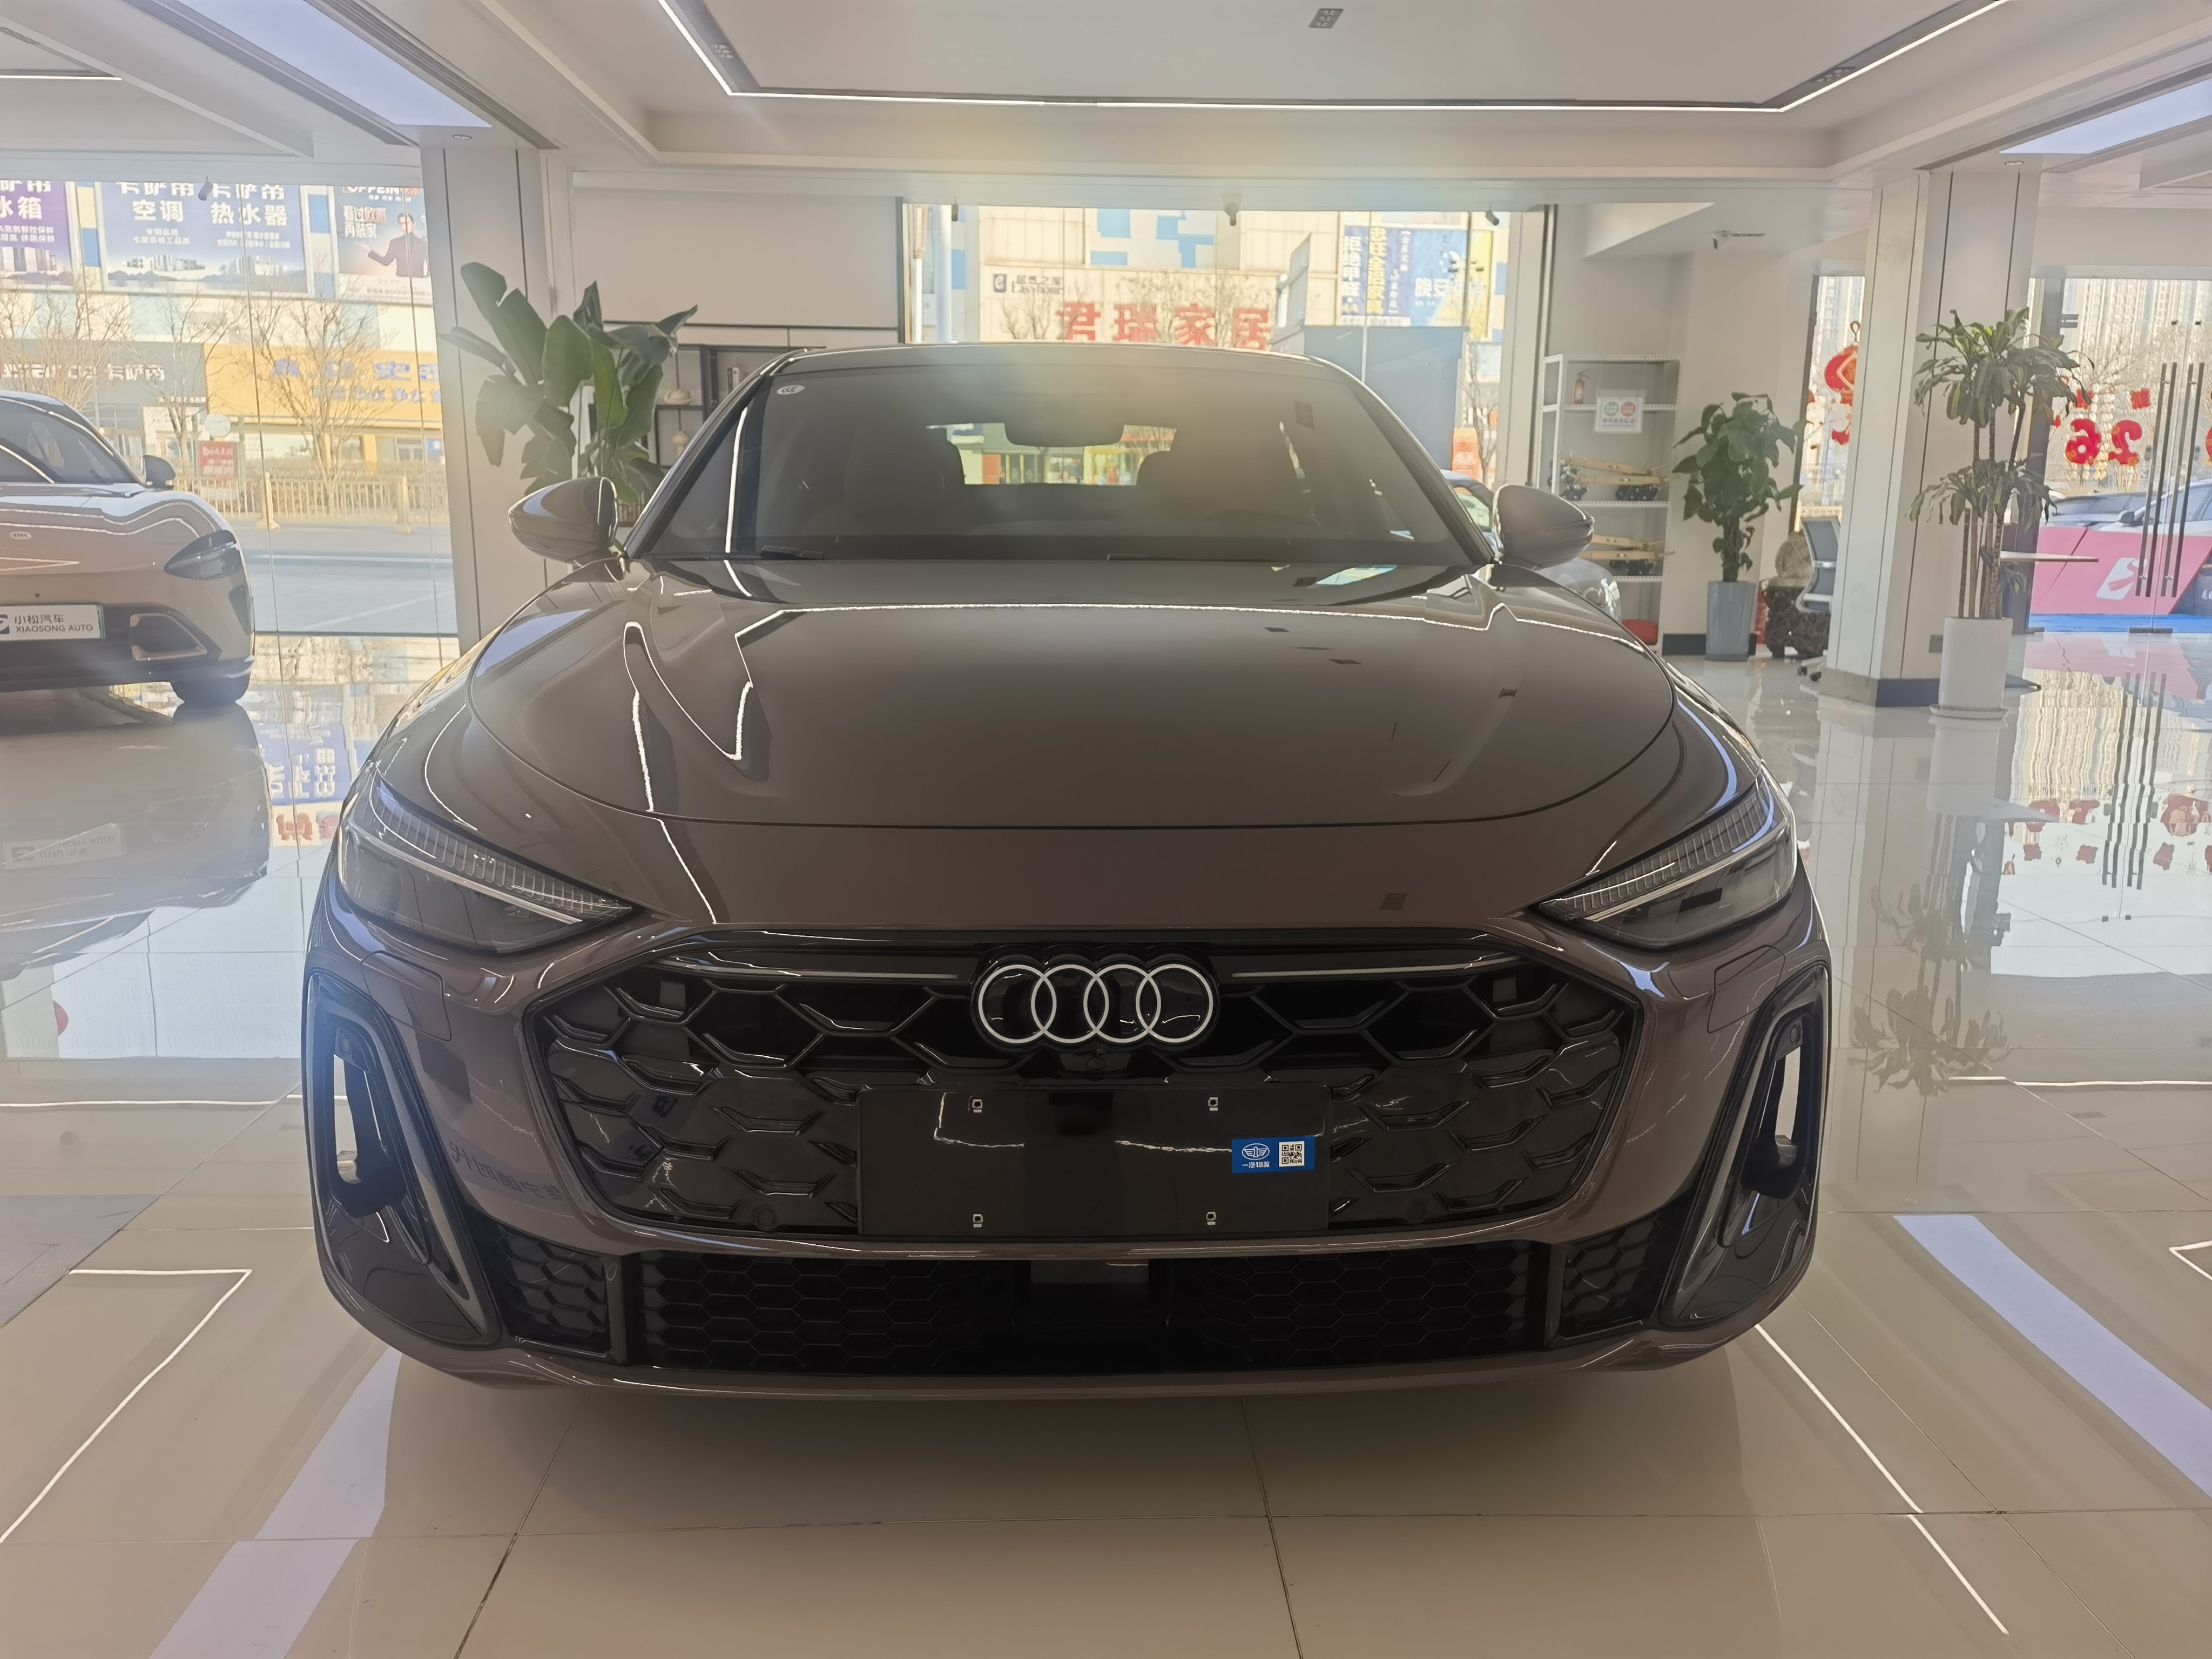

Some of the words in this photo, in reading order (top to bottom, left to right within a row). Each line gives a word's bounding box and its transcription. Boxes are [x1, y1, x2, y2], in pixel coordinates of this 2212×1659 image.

[132, 199, 184, 222] 空调
[211, 201, 287, 226] 热水器
[15, 614, 65, 625] 小松汽车
[16, 624, 65, 633] XIAOSONG
[69, 624, 93, 632] AUTO
